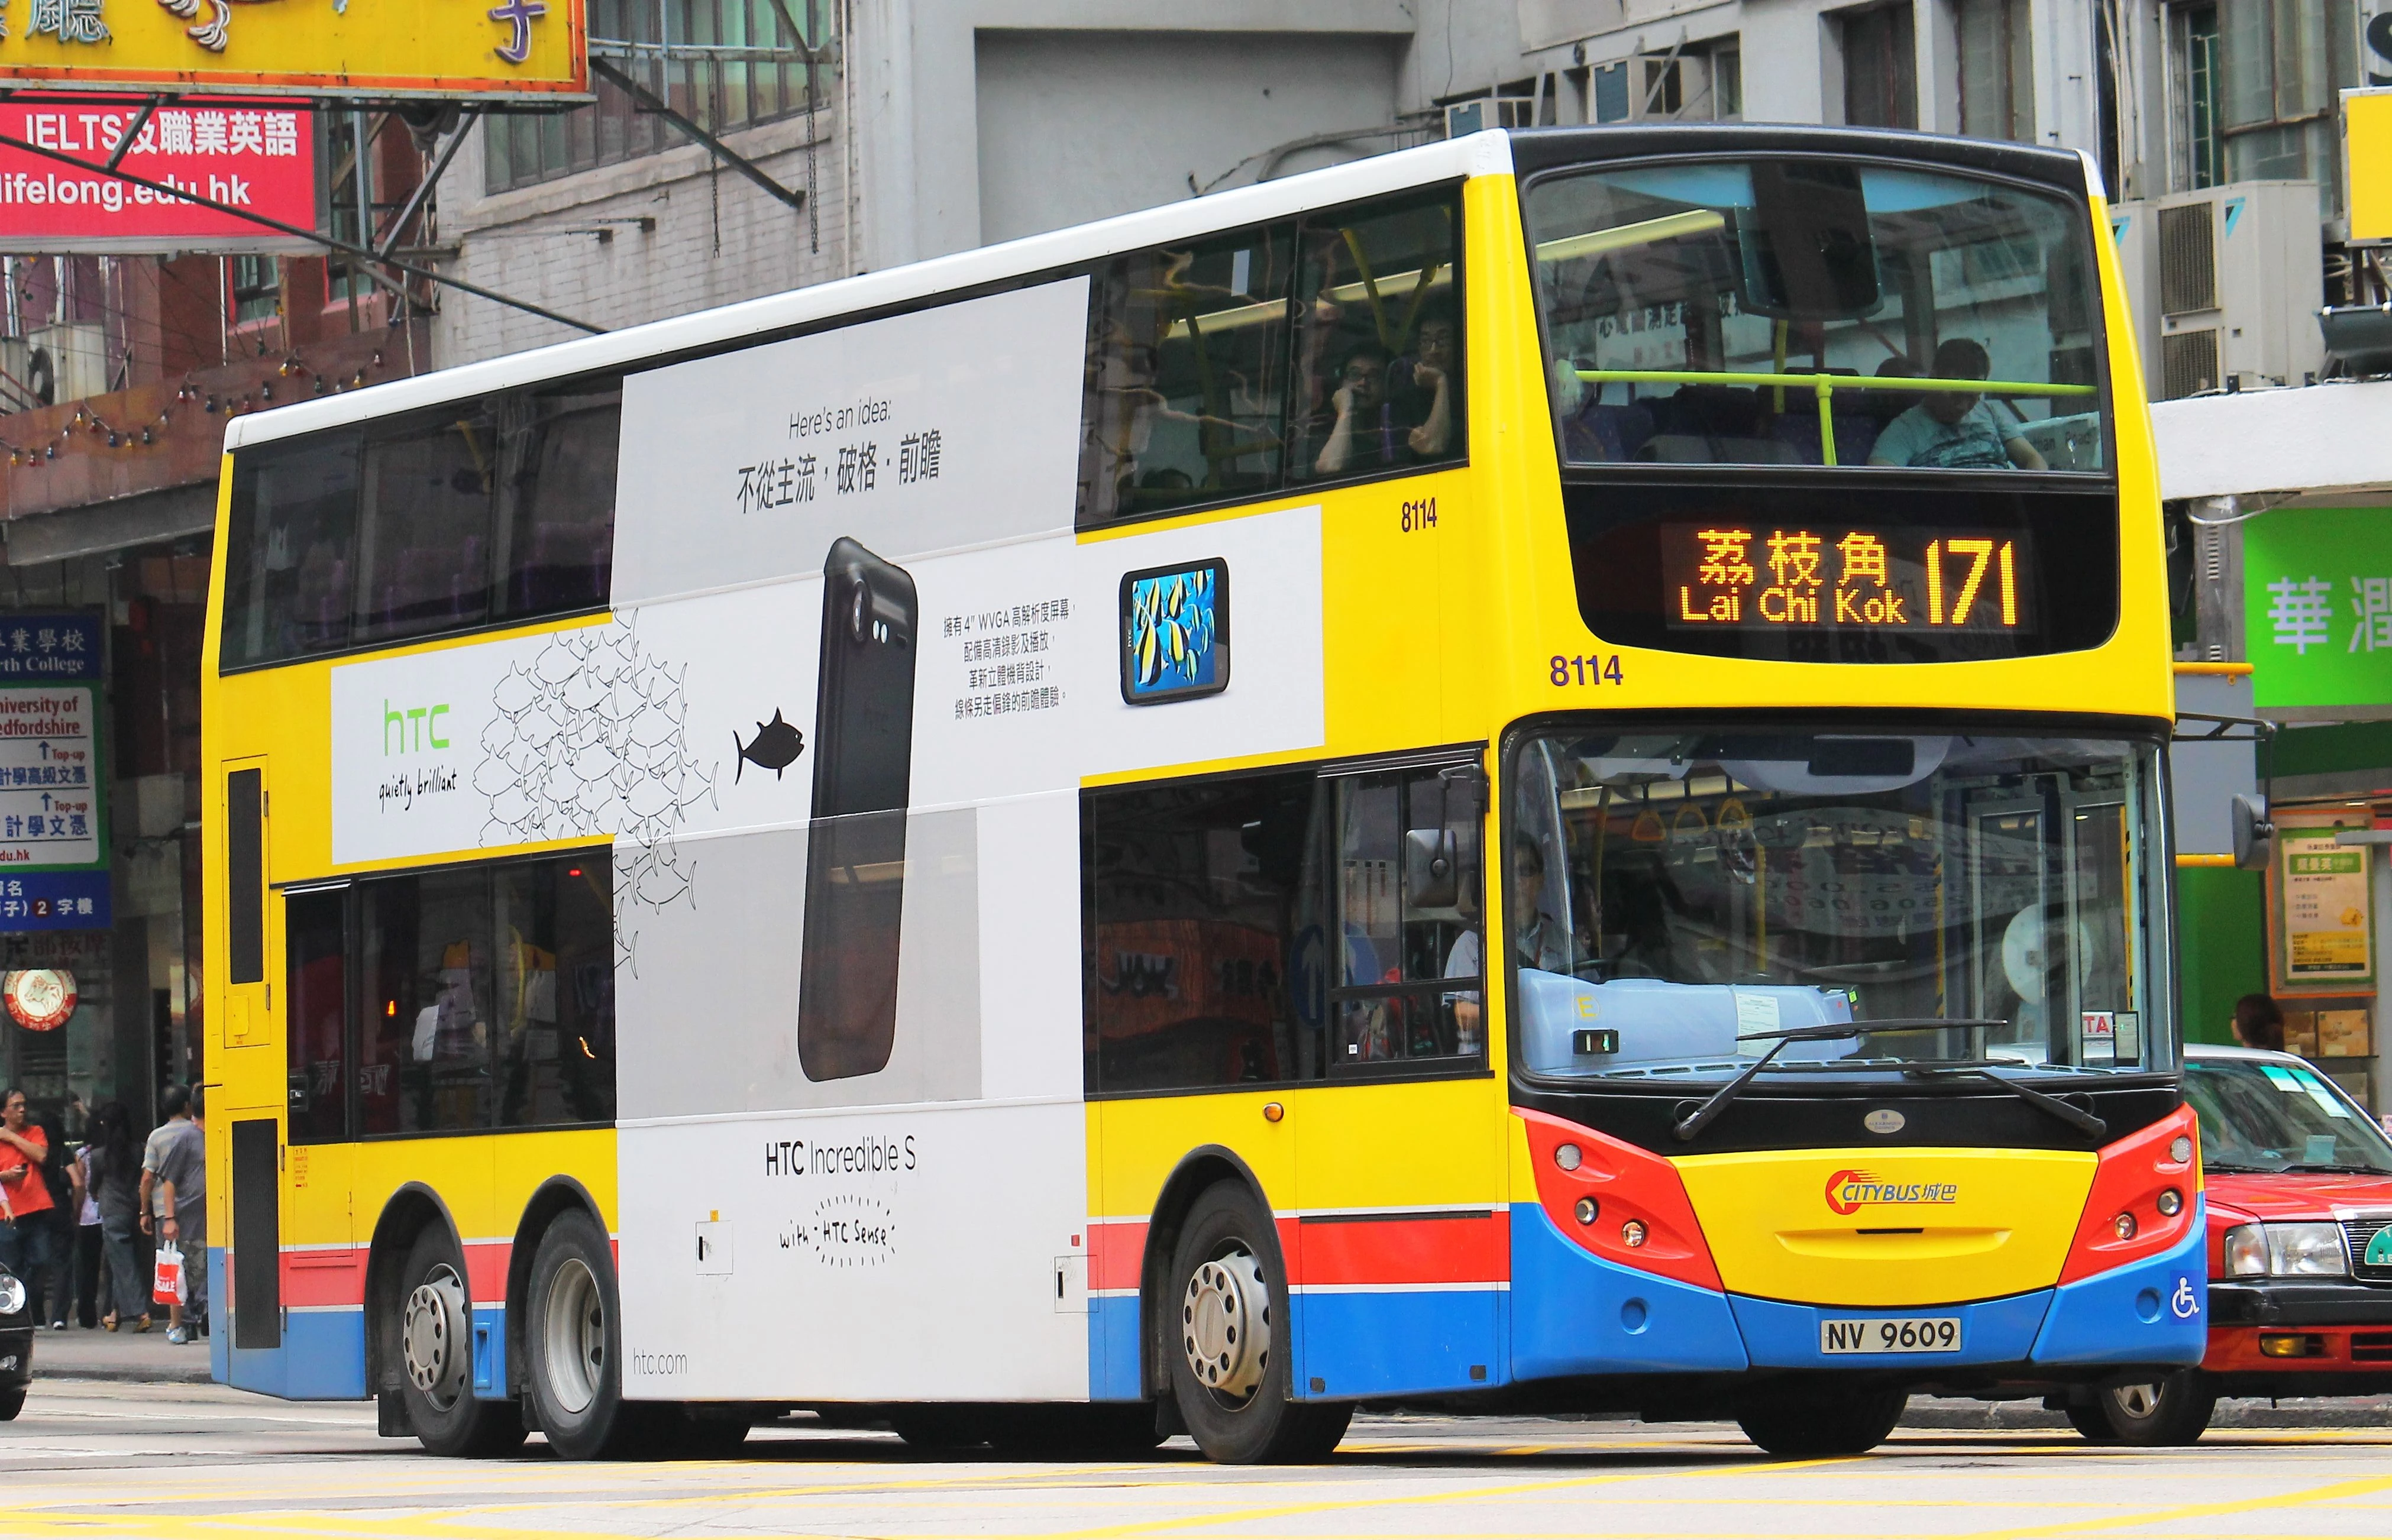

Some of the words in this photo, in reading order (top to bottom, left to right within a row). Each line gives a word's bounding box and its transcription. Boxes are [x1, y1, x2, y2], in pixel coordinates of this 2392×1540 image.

[26, 111, 298, 156] IELTS及職業英語
[0, 173, 251, 212] ifelong.eduhk
[789, 406, 832, 439] Here's
[836, 408, 854, 430] an
[858, 396, 891, 426] idea:
[1401, 497, 1437, 533] 8114
[1698, 529, 1886, 586] 荔枝角
[1926, 538, 2018, 625] 171
[1680, 585, 1740, 623] Lai
[1759, 587, 1818, 623] Chi
[1835, 588, 1908, 625] Kok
[978, 610, 1010, 631] WVGA
[0, 627, 85, 653] 業學校
[0, 658, 20, 672] th
[26, 656, 85, 674] College
[1550, 655, 1623, 687] 8114
[63, 696, 79, 712] of
[51, 748, 85, 762] Top-up
[379, 772, 412, 814] quietly
[417, 765, 457, 796] brilliant
[54, 800, 88, 813] Top-up
[2083, 1016, 2113, 1033] TA
[766, 1140, 804, 1176] HTC
[810, 1135, 898, 1175] Incredible
[904, 1135, 916, 1170] S
[1843, 1184, 1921, 1201] CITYBUS
[780, 1219, 809, 1249] with
[823, 1219, 848, 1244] HTC
[855, 1219, 887, 1246] Sense
[1828, 1323, 1865, 1350] NV
[1880, 1321, 1955, 1349] 9609
[633, 1347, 688, 1375] htc.com
